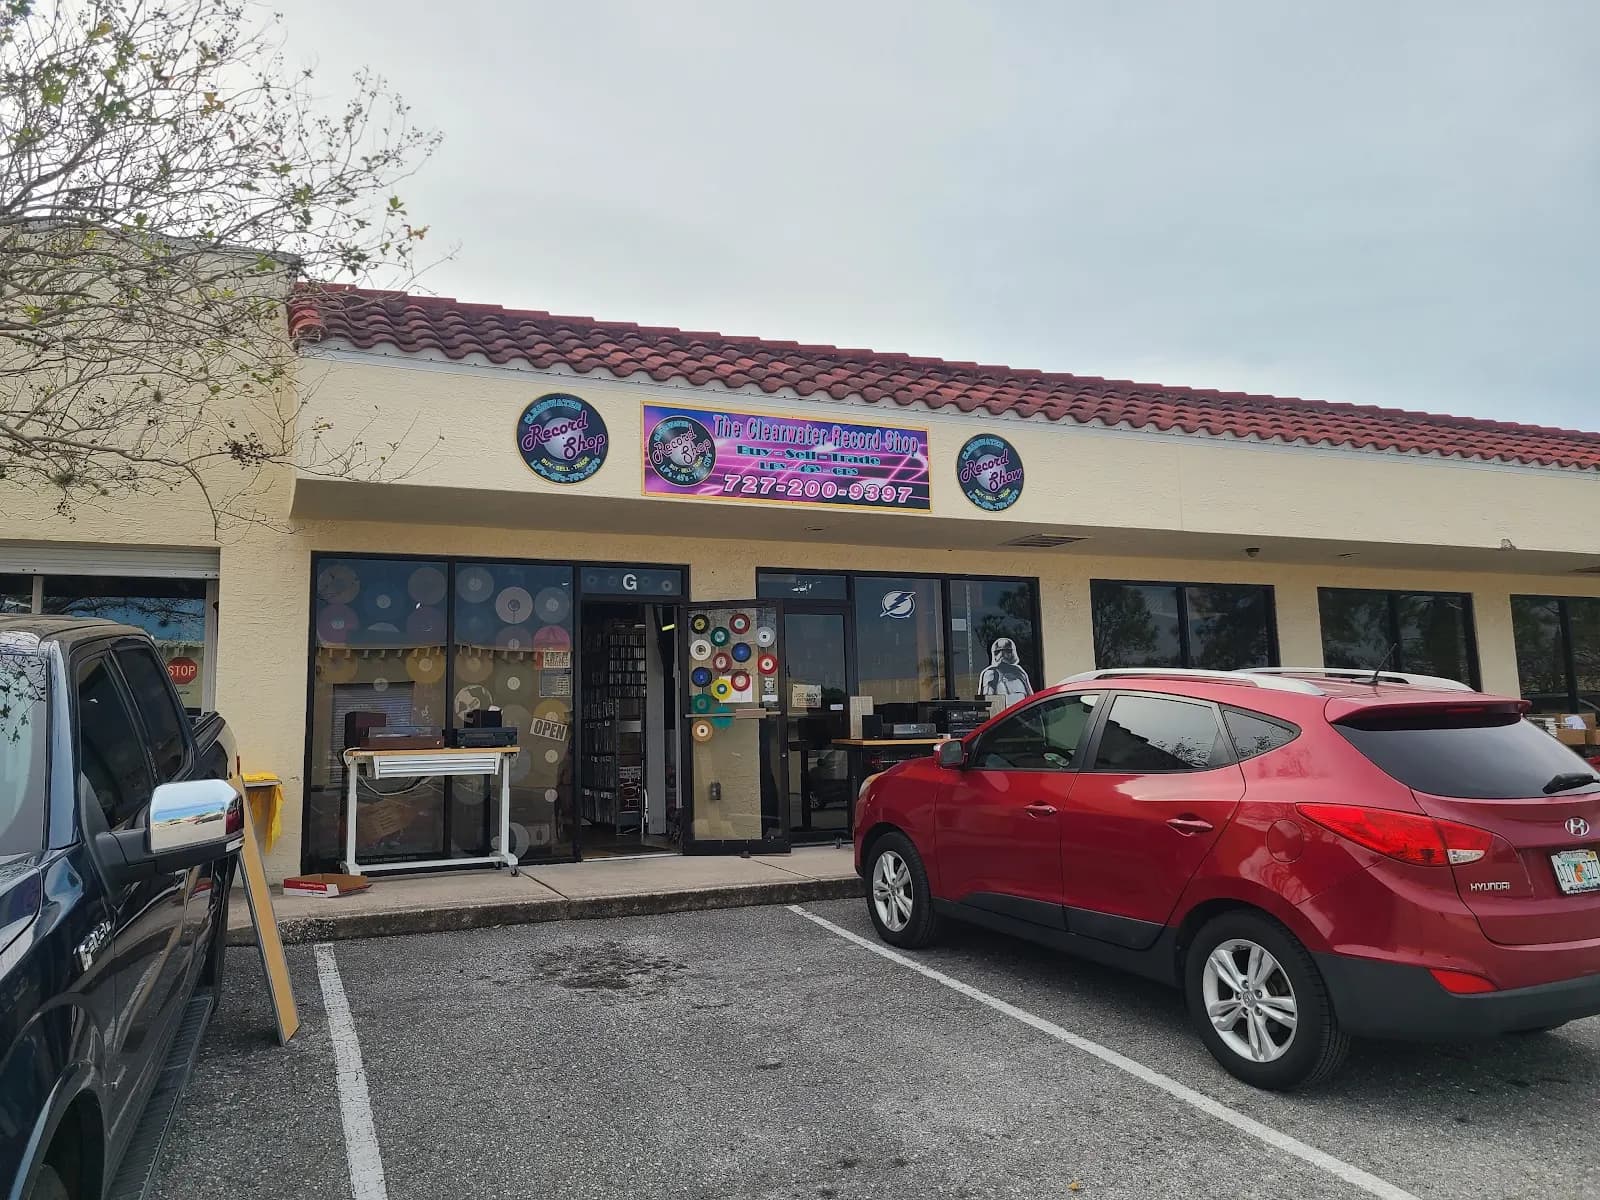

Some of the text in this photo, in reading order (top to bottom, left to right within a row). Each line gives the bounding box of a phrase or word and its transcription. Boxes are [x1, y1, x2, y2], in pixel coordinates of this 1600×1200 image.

[522, 410, 588, 451] Record
[713, 414, 919, 458] The Clearwater Record Shop
[563, 433, 605, 461] Shop
[653, 423, 697, 464] Record
[736, 445, 773, 457] Buy
[785, 448, 817, 461] Sell
[831, 452, 880, 465] Trade
[961, 448, 1009, 483] Record
[723, 474, 913, 503] 727-200-9397
[989, 469, 1022, 492] Show
[622, 573, 638, 590] G
[168, 665, 195, 677] STOP
[533, 720, 566, 739] OPEN
[1470, 881, 1511, 891] HYUNDAI
